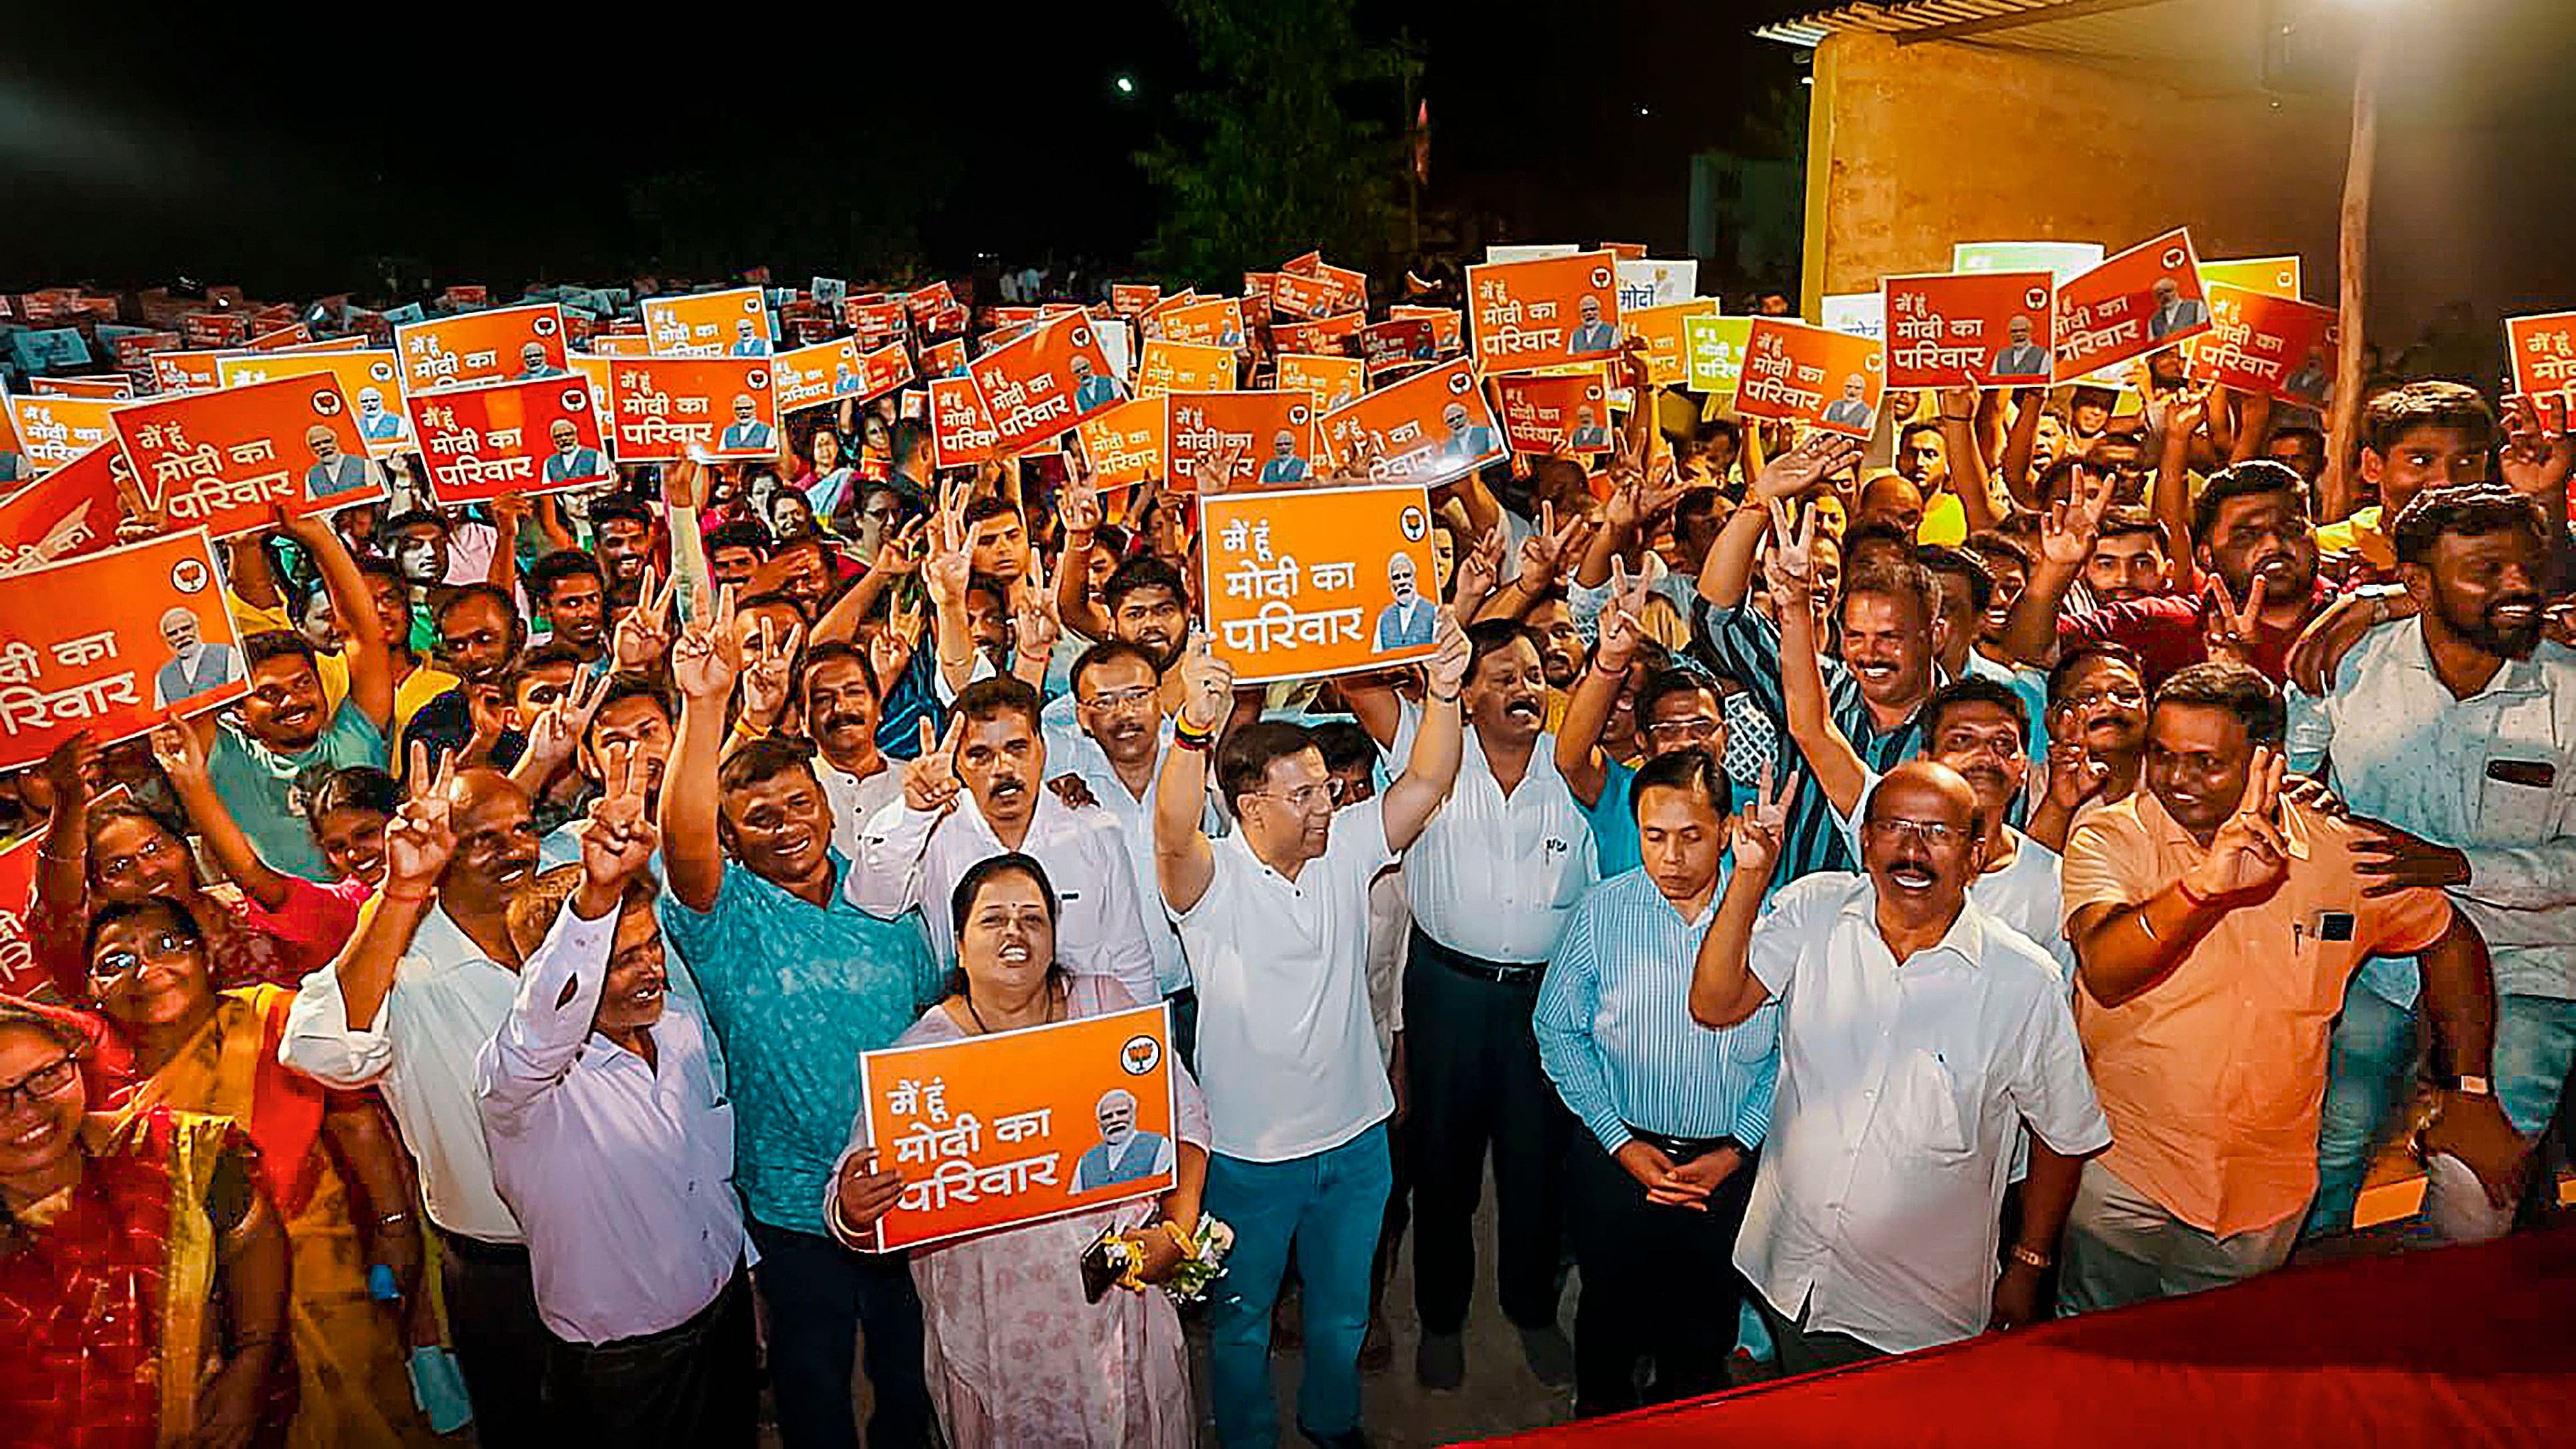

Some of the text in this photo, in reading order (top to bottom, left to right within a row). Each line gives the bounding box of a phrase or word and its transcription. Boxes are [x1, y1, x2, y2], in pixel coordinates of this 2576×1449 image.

[1479, 278, 1507, 302] मैं हूं
[1482, 301, 1557, 325] मोदी का
[1895, 292, 1927, 317] मैं हूं
[2097, 295, 2130, 319] का
[2215, 299, 2242, 324] मैं हूं
[1483, 326, 1561, 355] परिवार
[1897, 314, 1943, 339] मोदी
[1950, 319, 1983, 337] का
[408, 335, 441, 357] मैं हूं
[1757, 334, 1783, 357] मैं हूं
[1894, 341, 1985, 369] परिवार
[2255, 334, 2283, 353] का
[2526, 331, 2573, 356] मैं हूं
[414, 350, 497, 378] मोदी का
[1753, 354, 1825, 384] मोदी का
[2201, 345, 2282, 379] परिवार
[621, 371, 653, 395] मैं हूं
[981, 367, 1011, 391] मैं हूं
[992, 374, 1055, 410] मोदी का
[622, 392, 670, 415] मोदी
[675, 397, 709, 414] का
[1745, 379, 1823, 411] परिवार
[421, 406, 459, 432] मैं हूं
[999, 395, 1070, 436] परिवार
[1175, 407, 1204, 430] मैं हूं
[135, 421, 191, 451] मैं हूं
[430, 427, 523, 455] मोदी का
[621, 417, 713, 445] परिवार
[942, 427, 999, 451] परिवा
[1176, 428, 1216, 450] मोदी
[152, 439, 275, 483] मोदी का
[435, 455, 534, 486] परिवार
[1369, 445, 1433, 484] रिवार
[169, 471, 296, 520] परिवार
[1219, 518, 1273, 562] मैं हूं
[1224, 554, 1355, 600] मोदी का
[1221, 601, 1364, 653] परिवार
[51, 631, 118, 666] का
[0, 671, 142, 735] रिवार
[886, 1076, 951, 1124] मैं हूं
[892, 1108, 1052, 1164] मोदी का
